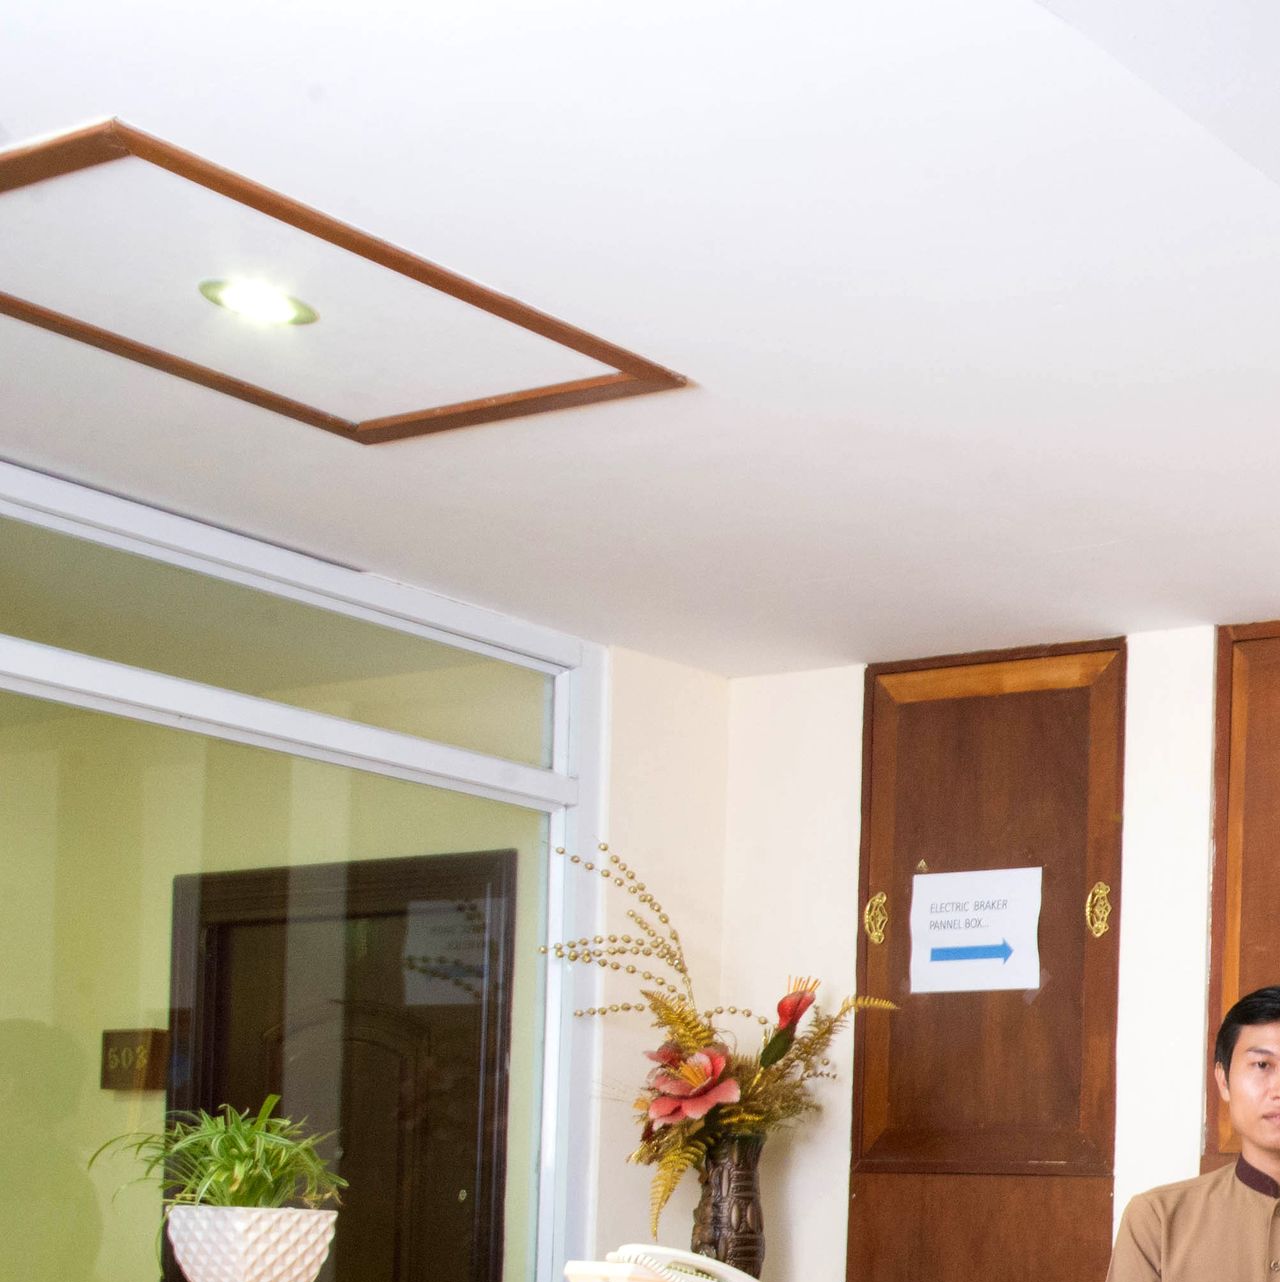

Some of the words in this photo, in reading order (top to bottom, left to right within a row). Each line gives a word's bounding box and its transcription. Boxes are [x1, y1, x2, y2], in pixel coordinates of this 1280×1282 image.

[930, 901, 970, 914] ELECTRIC
[974, 899, 1008, 911] BRAKER
[929, 919, 963, 930] PANNEL
